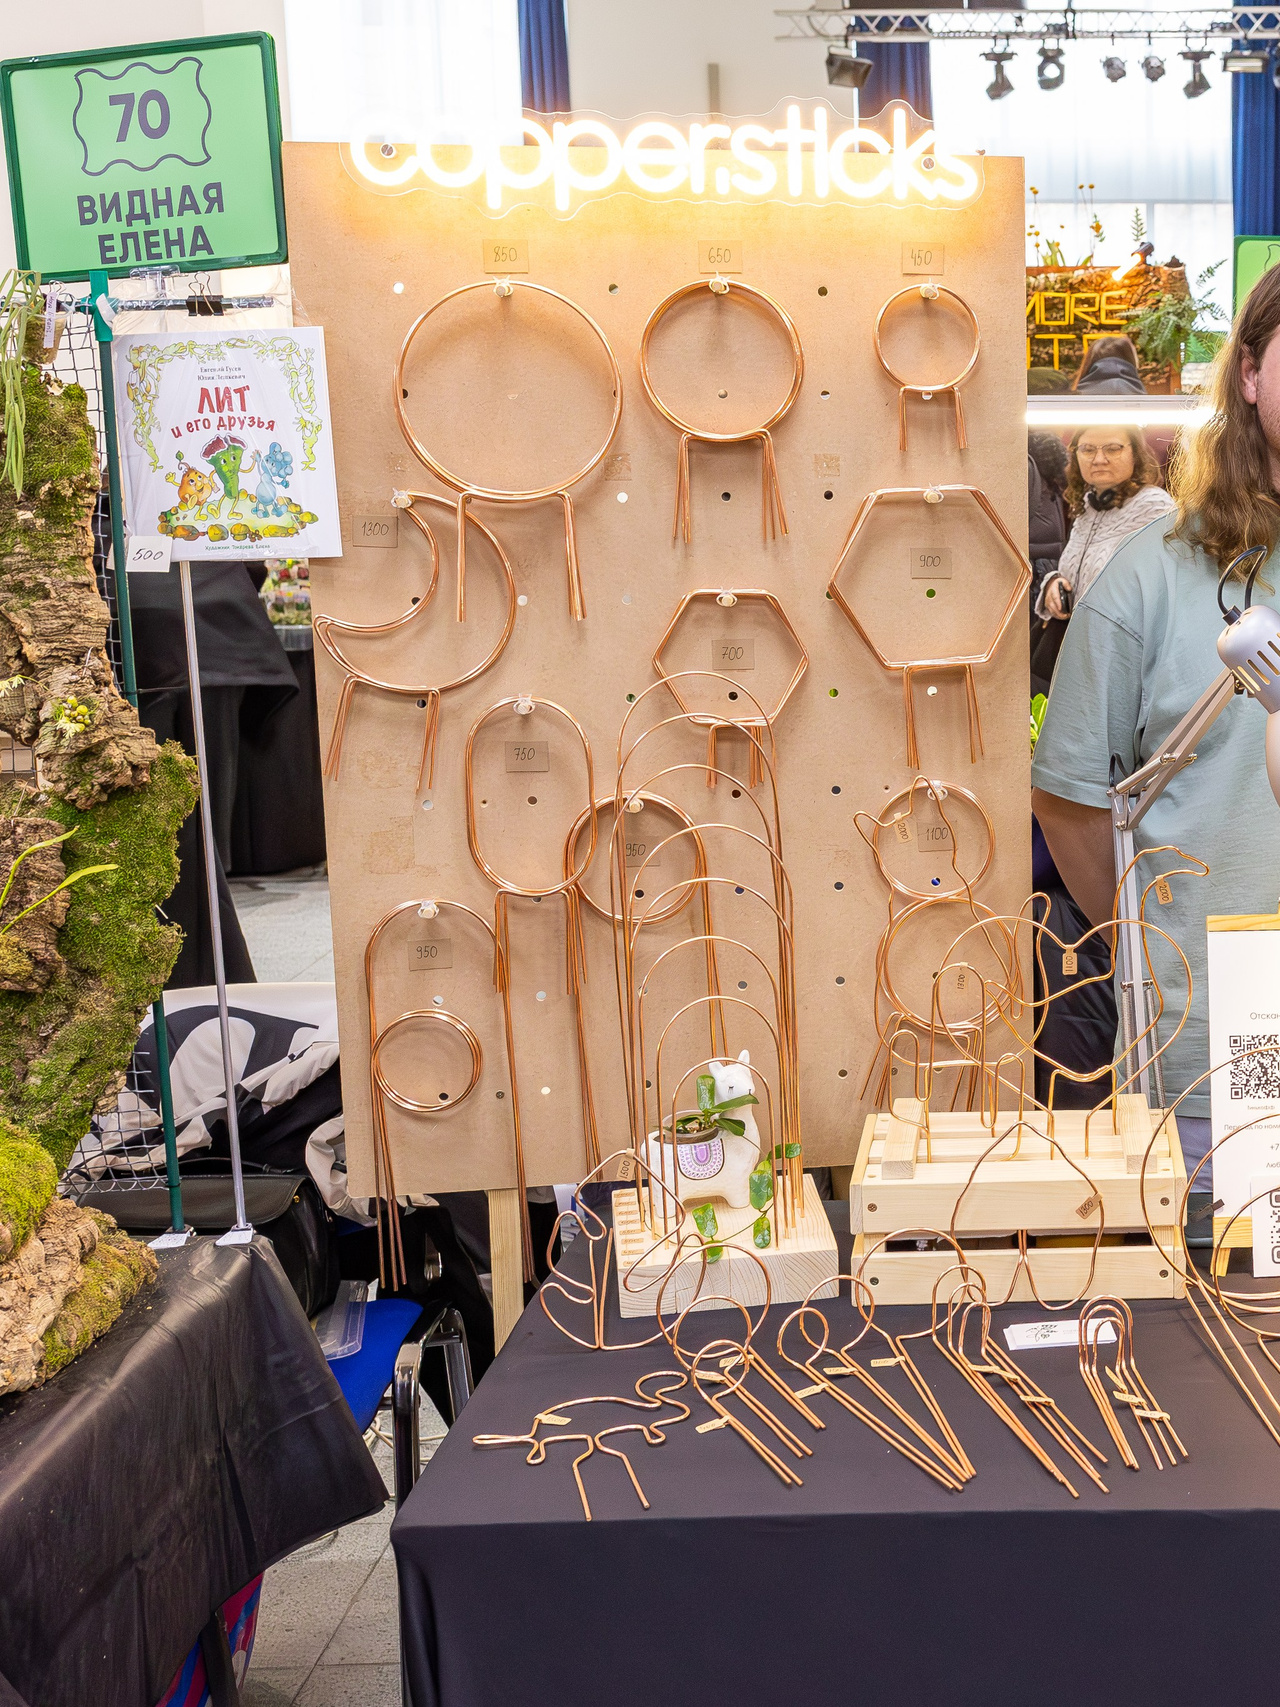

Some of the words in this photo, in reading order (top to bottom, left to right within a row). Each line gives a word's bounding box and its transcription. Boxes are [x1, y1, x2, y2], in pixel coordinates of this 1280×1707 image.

[108, 89, 171, 143] 70
[349, 104, 979, 211] copper.sticks
[77, 182, 225, 226] ВИДНАЯ
[98, 225, 215, 266] ЕЛЕНА
[494, 247, 518, 264] 850
[708, 247, 732, 264] 650
[910, 249, 933, 265] 450
[198, 385, 250, 414] ЛИТ
[171, 425, 183, 439] и
[186, 418, 211, 433] его
[217, 415, 276, 432] друзья
[362, 521, 389, 538] 1300
[132, 548, 164, 562] 500
[919, 554, 941, 569] 900
[722, 646, 744, 661] 700
[514, 747, 536, 761] 750
[897, 822, 909, 840] 2000
[926, 827, 949, 841] 1100
[1159, 884, 1170, 902] 2000
[416, 945, 438, 959] 950
[1065, 955, 1074, 972] 1100
[957, 974, 966, 990] 1300
[620, 1161, 631, 1179] 1500
[1079, 1200, 1094, 1217] 1300
